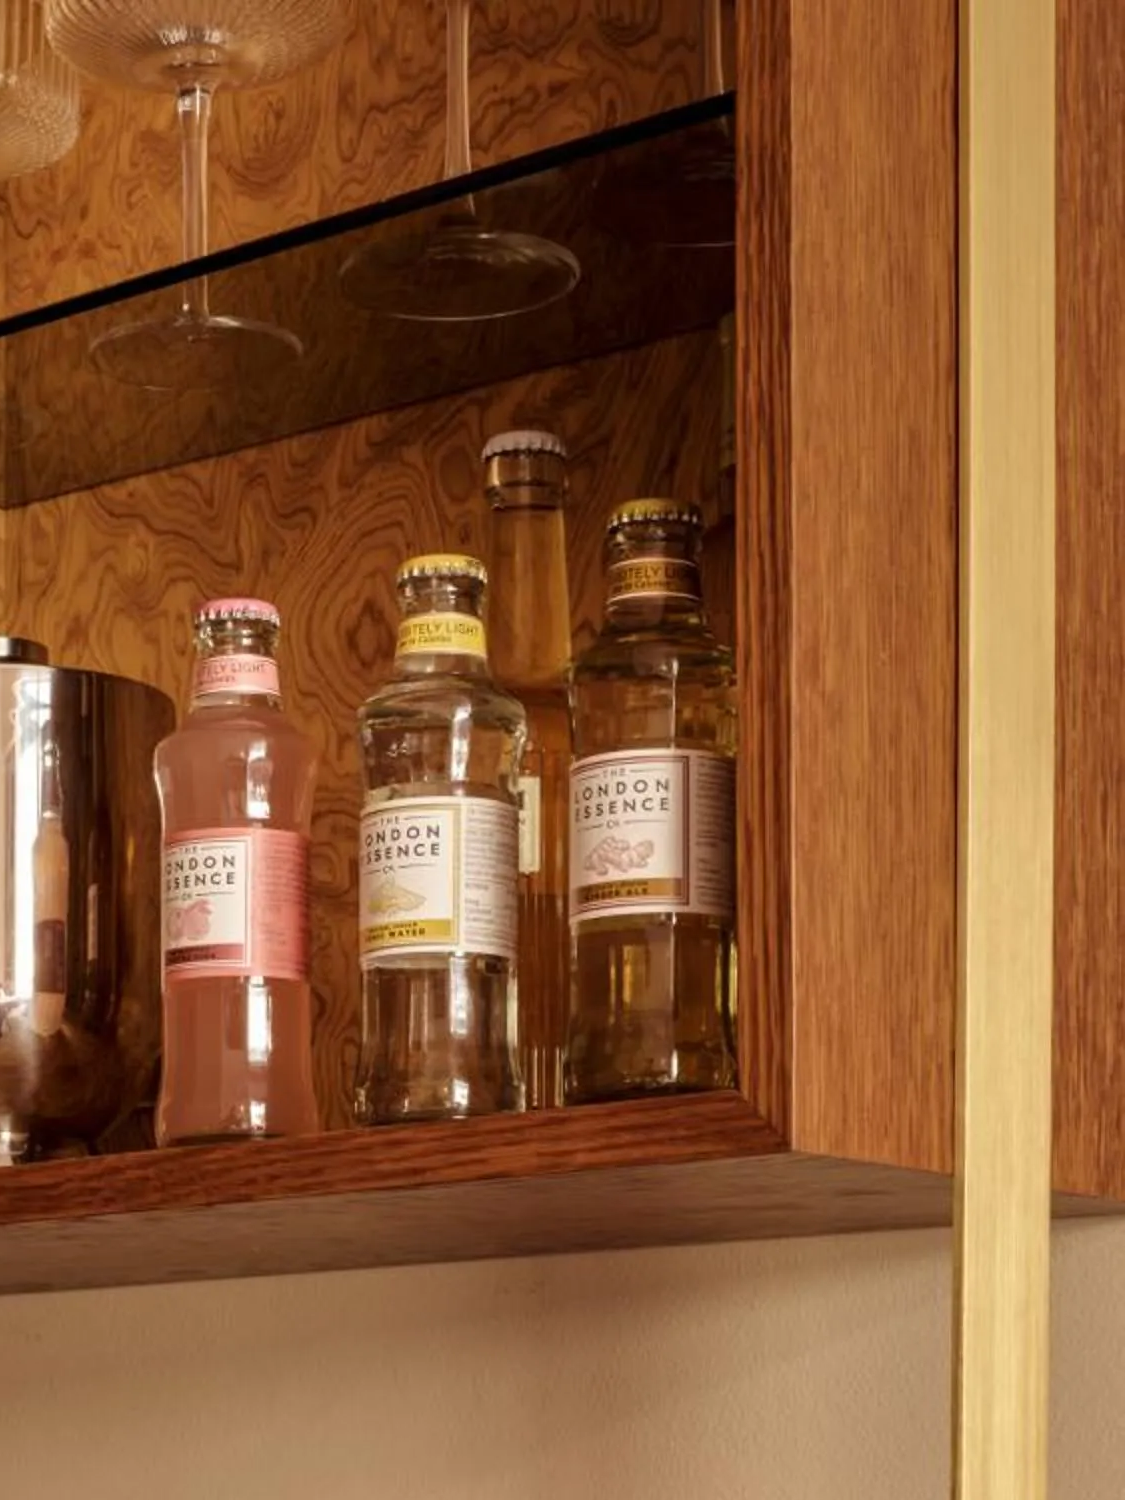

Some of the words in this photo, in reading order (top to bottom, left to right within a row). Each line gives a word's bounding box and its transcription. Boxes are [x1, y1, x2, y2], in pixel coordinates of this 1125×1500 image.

[602, 768, 626, 777] THE
[365, 825, 440, 848] ONDON
[366, 844, 440, 864] SSENCE
[166, 856, 236, 876] ONDON
